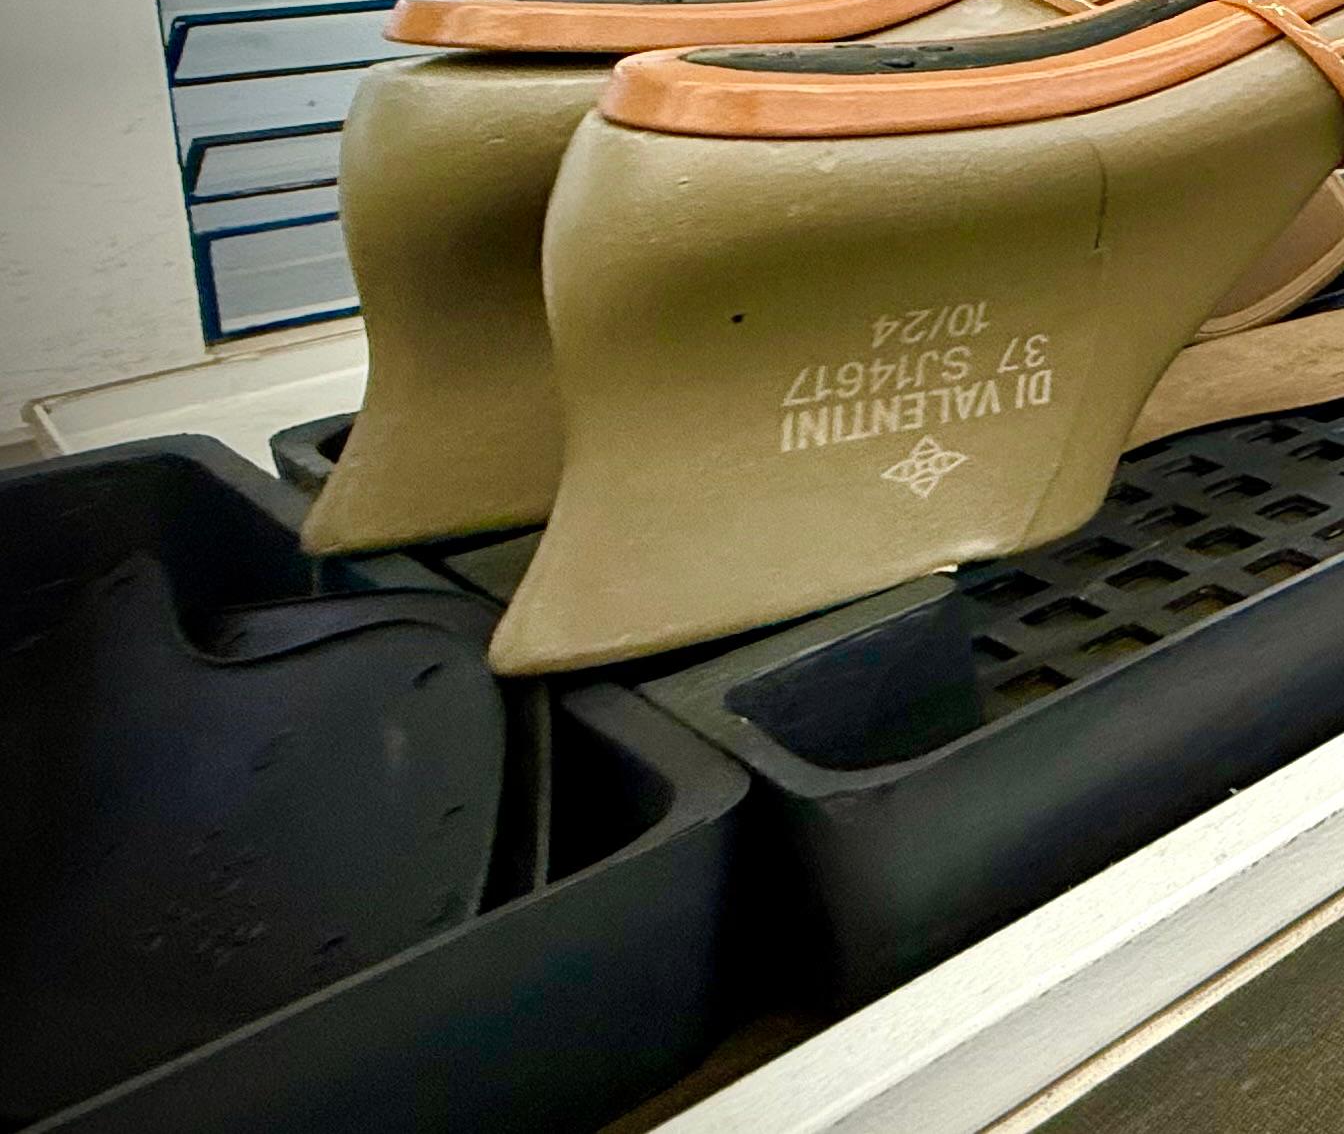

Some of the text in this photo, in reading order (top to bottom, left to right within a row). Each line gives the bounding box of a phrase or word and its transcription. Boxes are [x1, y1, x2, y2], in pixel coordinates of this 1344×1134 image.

[871, 301, 991, 349] 10/24
[781, 333, 1049, 408] 37 SJ14617
[781, 369, 1053, 453] DI VALENTINI
